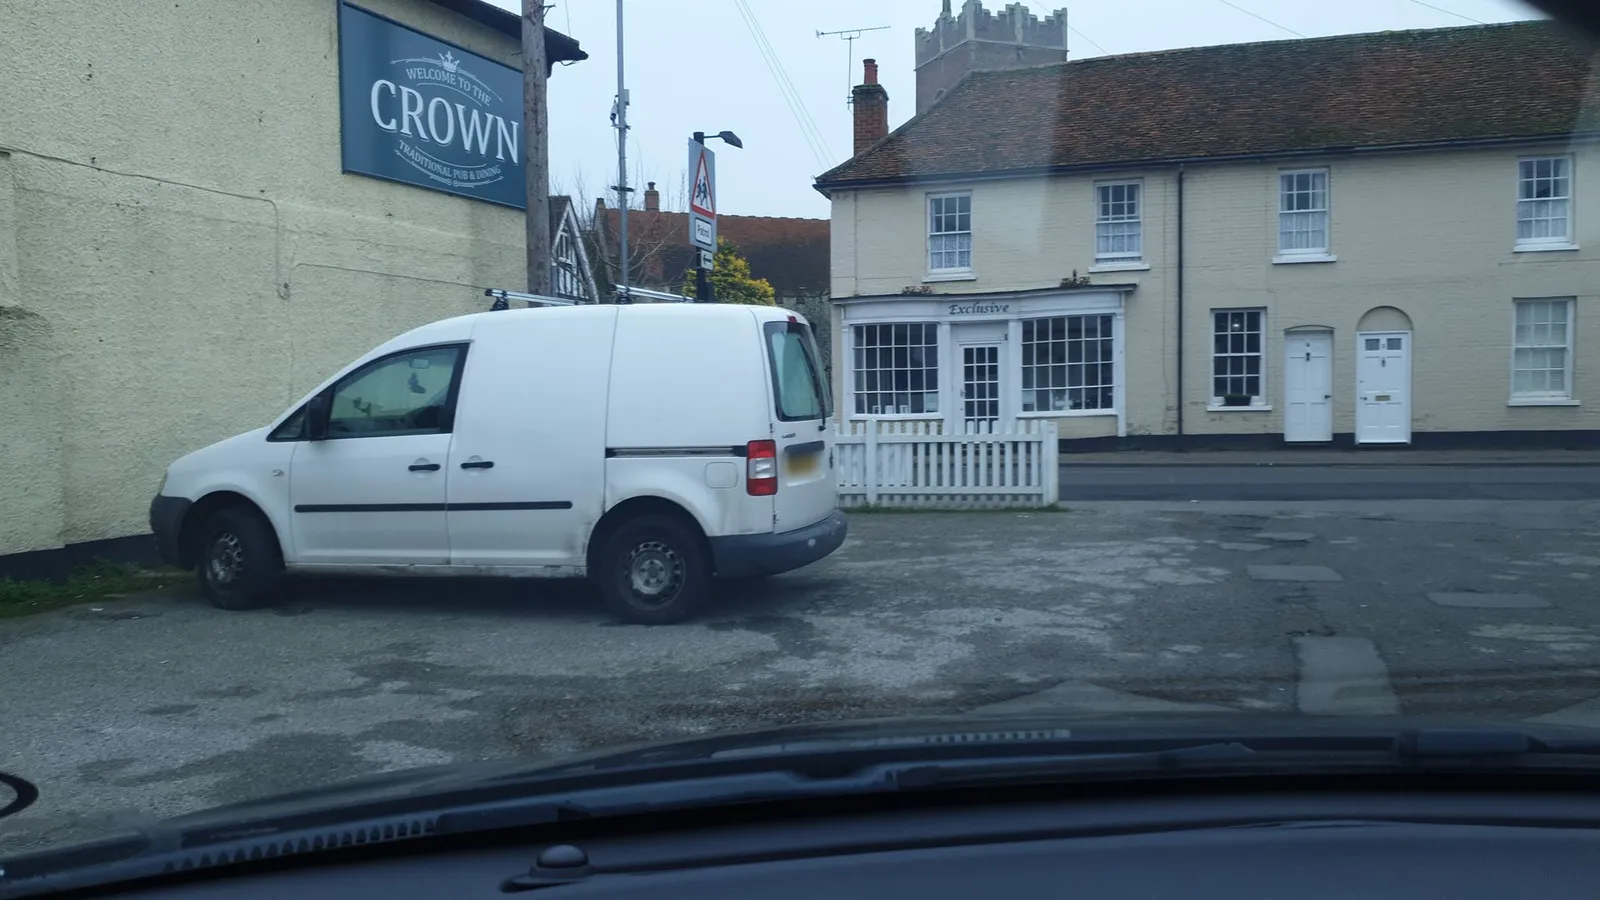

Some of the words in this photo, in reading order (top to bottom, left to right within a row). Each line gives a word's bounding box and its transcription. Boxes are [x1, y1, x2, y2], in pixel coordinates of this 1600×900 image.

[405, 68, 456, 85] WELCOME
[457, 76, 471, 92] TO
[472, 84, 492, 106] THE
[371, 79, 519, 164] CROWN
[399, 139, 452, 179] TRADITIONAL
[453, 168, 469, 180] PUB
[470, 171, 476, 180] &
[477, 165, 501, 179] DINING
[948, 301, 1010, 315] Exclusive
